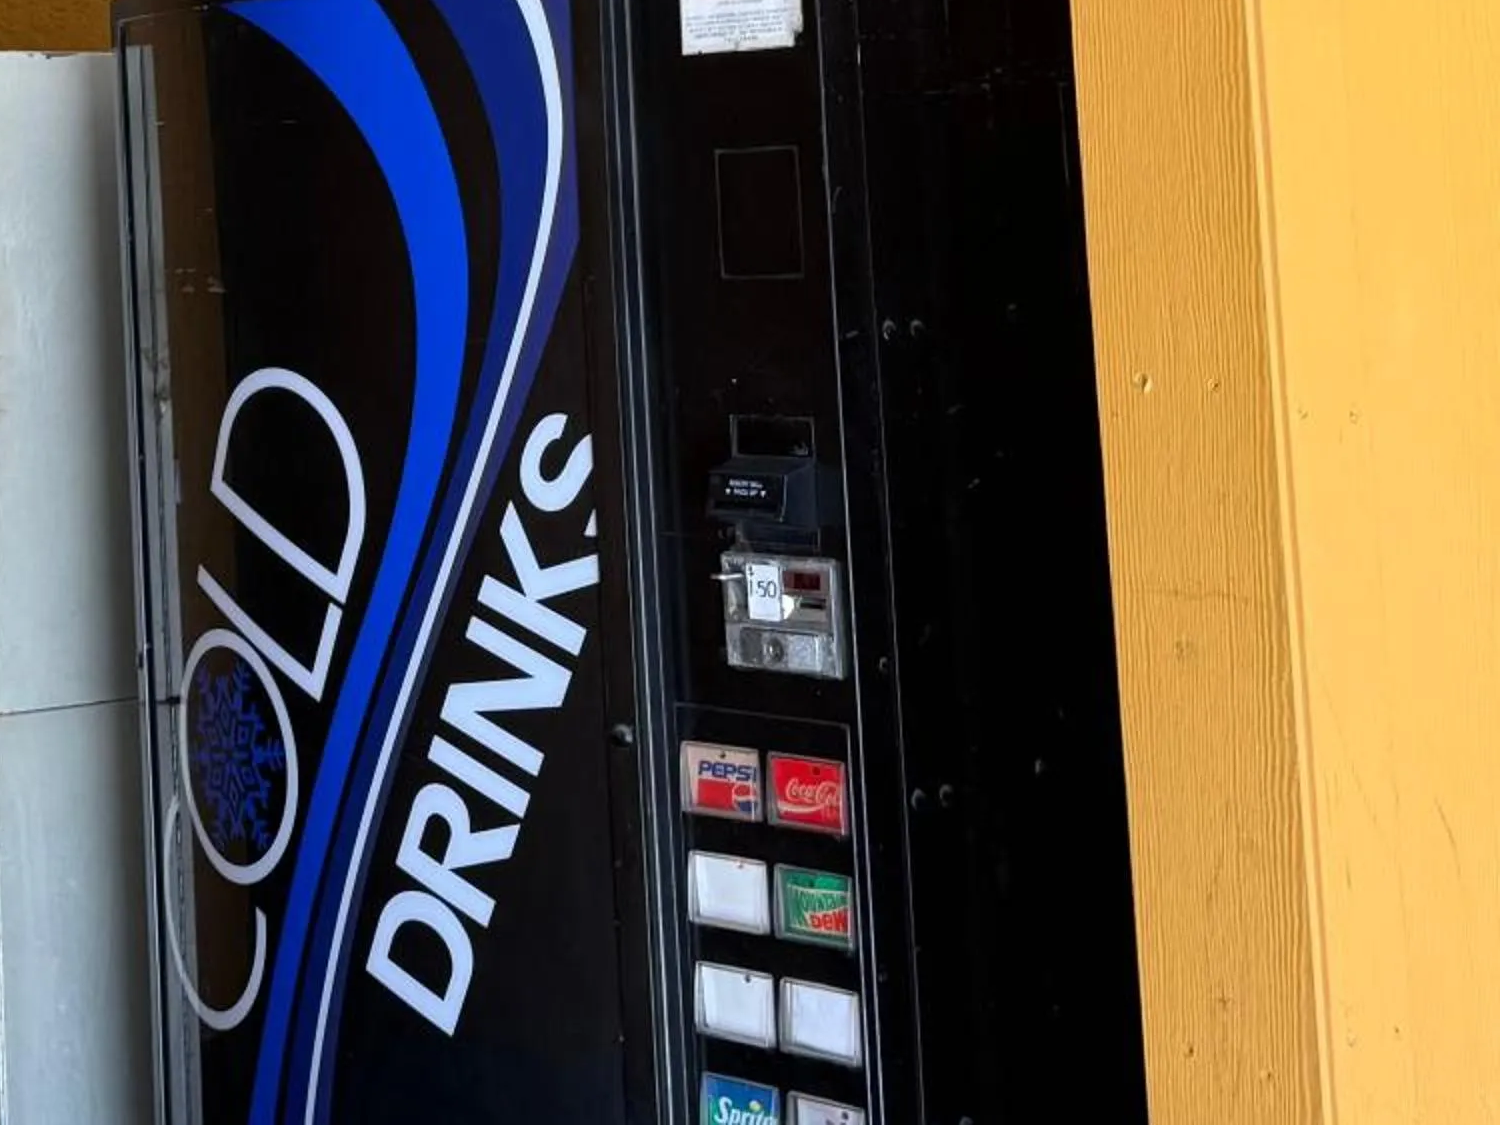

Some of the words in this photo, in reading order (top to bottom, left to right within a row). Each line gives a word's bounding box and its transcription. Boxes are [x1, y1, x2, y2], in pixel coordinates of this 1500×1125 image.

[164, 367, 366, 1031] COLD
[365, 413, 600, 1037] DRINKS
[698, 760, 757, 783] PEPSI
